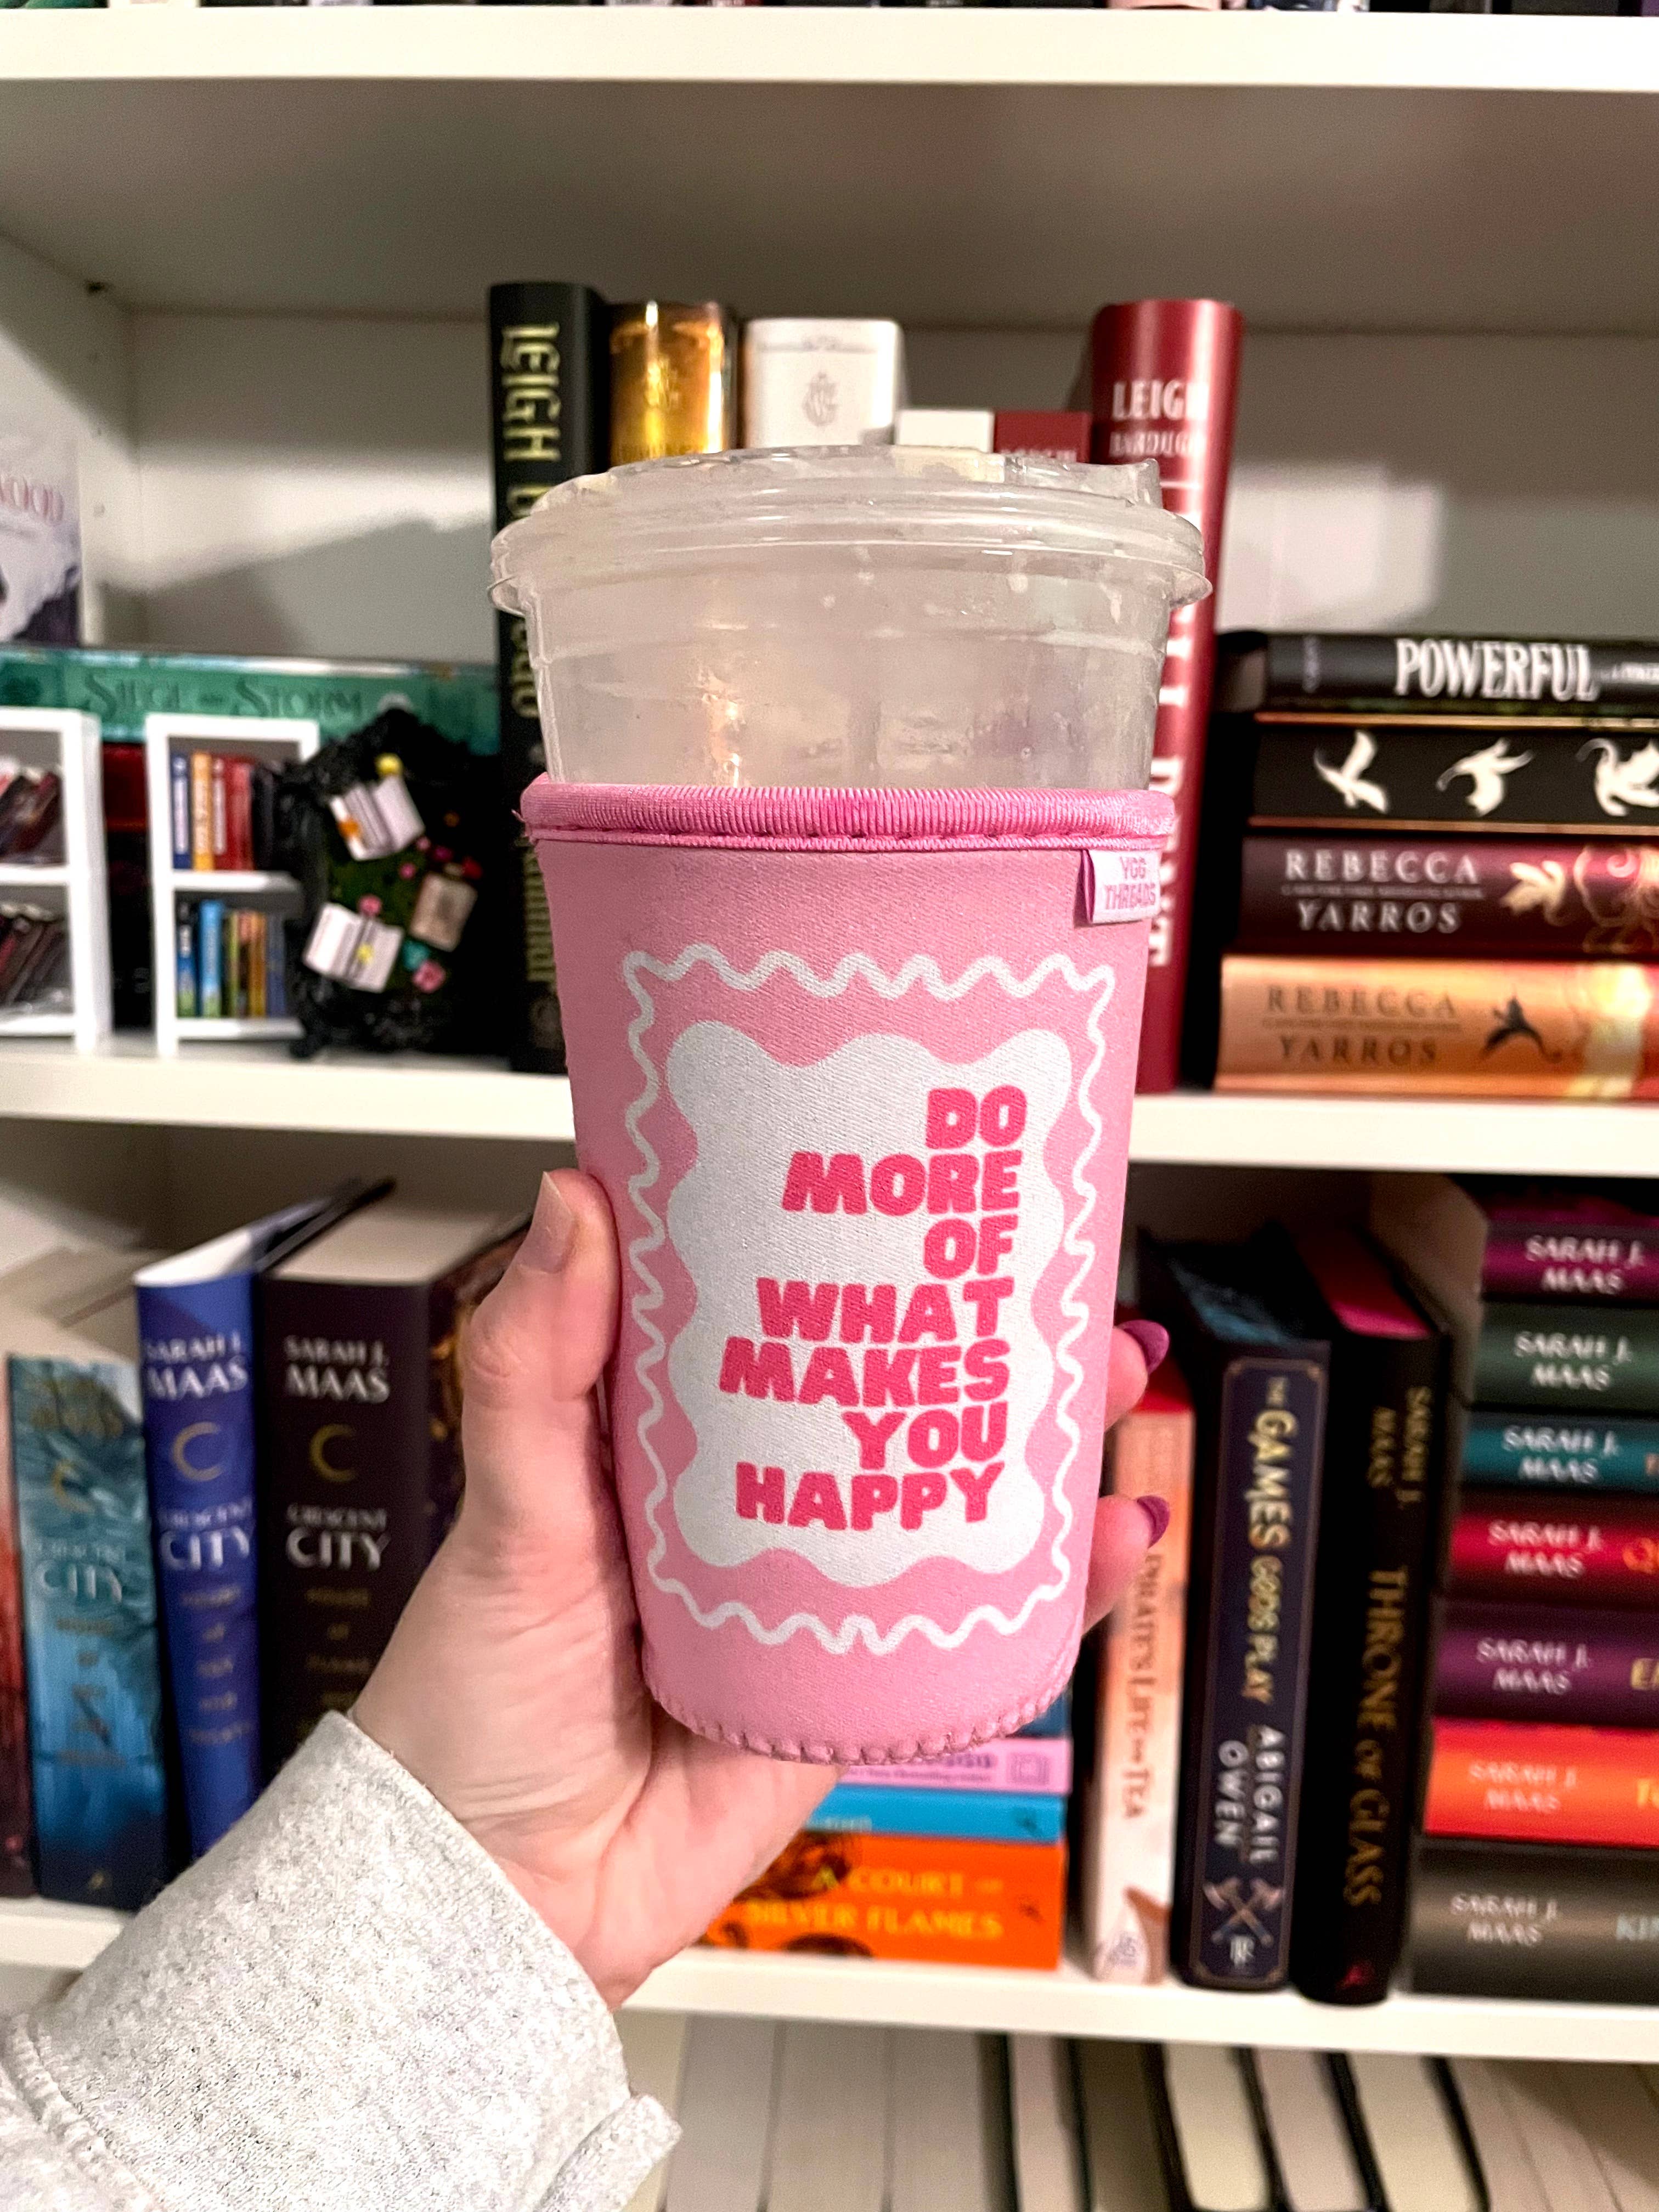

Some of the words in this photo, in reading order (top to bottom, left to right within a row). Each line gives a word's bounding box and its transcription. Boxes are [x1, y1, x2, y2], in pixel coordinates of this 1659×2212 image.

[501, 322, 561, 462] LEIGH
[1394, 637, 1600, 702] POWERFUL
[1284, 849, 1480, 885] REBECCA
[1297, 901, 1462, 934] YARROS
[1267, 986, 1458, 1018] REBECCA
[1279, 1035, 1438, 1068] YARROS
[925, 1084, 1028, 1149] DO
[781, 1149, 1023, 1217] MORE
[923, 1214, 1019, 1280] OF
[1525, 1234, 1621, 1266] SARAH
[1542, 1267, 1624, 1295] MAAS
[756, 1276, 1015, 1345] WHAT
[1514, 1330, 1607, 1360] SARAH
[145, 1355, 249, 1401] MAAS
[286, 1362, 390, 1404] MAAS
[719, 1335, 1011, 1408] MAKES
[1532, 1362, 1612, 1391] MAAS
[841, 1400, 1009, 1471] YOU
[1502, 1425, 1595, 1454] SARAH
[1244, 1409, 1298, 1551] GAMES
[1519, 1457, 1599, 1483] MAAS
[735, 1460, 1006, 1532] HAPPY
[160, 1524, 255, 1571] CITY
[286, 1527, 392, 1571] CITY
[1487, 1519, 1581, 1547] SARAH
[1505, 1551, 1585, 1579] MAAS
[1358, 1567, 1408, 1731] THRONE
[1476, 1637, 1567, 1666] SARAH
[1241, 1634, 1278, 1705] PLAY
[1493, 1667, 1572, 1695] MAAS
[1468, 1761, 1558, 1785] SARAH
[1214, 1740, 1250, 1847] OWEN
[1249, 1725, 1286, 1864] ABIGAIL
[1485, 1787, 1561, 1814] MAAS
[1343, 1787, 1390, 1908] GLASS
[848, 1866, 964, 1898] COURT
[866, 1905, 1005, 1940] FLAMES
[1450, 1892, 1538, 1919] SARAH
[1466, 1921, 1544, 1947] MAAS
